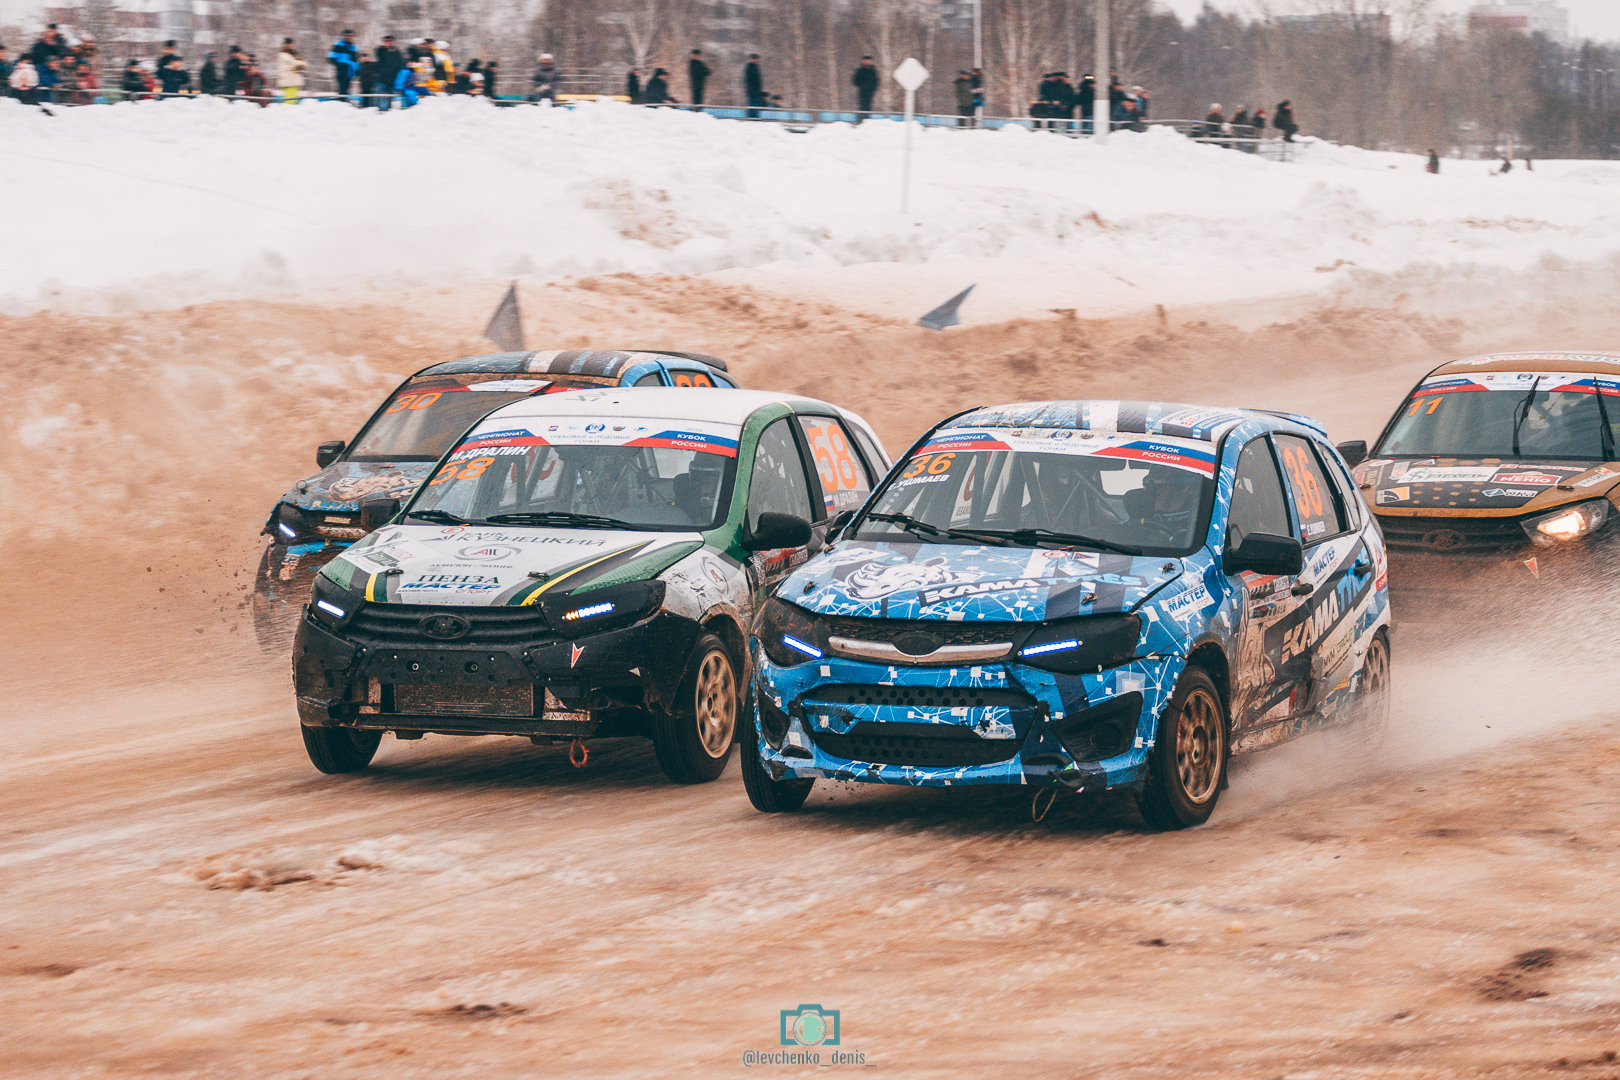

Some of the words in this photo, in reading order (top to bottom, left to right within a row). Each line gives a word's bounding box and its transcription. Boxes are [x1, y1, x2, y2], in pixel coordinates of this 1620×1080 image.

[386, 392, 442, 414] 30
[1408, 396, 1443, 416] 11
[477, 430, 525, 440] ЧЕМПИОНАТ
[676, 433, 706, 441] КУБОК
[936, 433, 987, 444] ЧЕМПИОНАТ
[478, 438, 512, 446] РОССИИ
[671, 440, 708, 449] РОССИИ
[937, 441, 972, 449] РОССИИ
[446, 445, 532, 463] М.ДРАЛИН
[1148, 444, 1180, 454] КУБОК
[806, 423, 858, 493] 58
[1142, 451, 1181, 462] РОССИИ
[903, 452, 957, 479] 36
[428, 456, 496, 487] 58
[1282, 446, 1323, 519] 36
[1500, 476, 1551, 484] МЕНЮ
[456, 535, 608, 547] КУЗНЕЦКИЙ
[416, 574, 500, 584] ПЕНЗА
[401, 582, 502, 590] МАСТЕР
[1167, 585, 1206, 613] МАСТЕР
